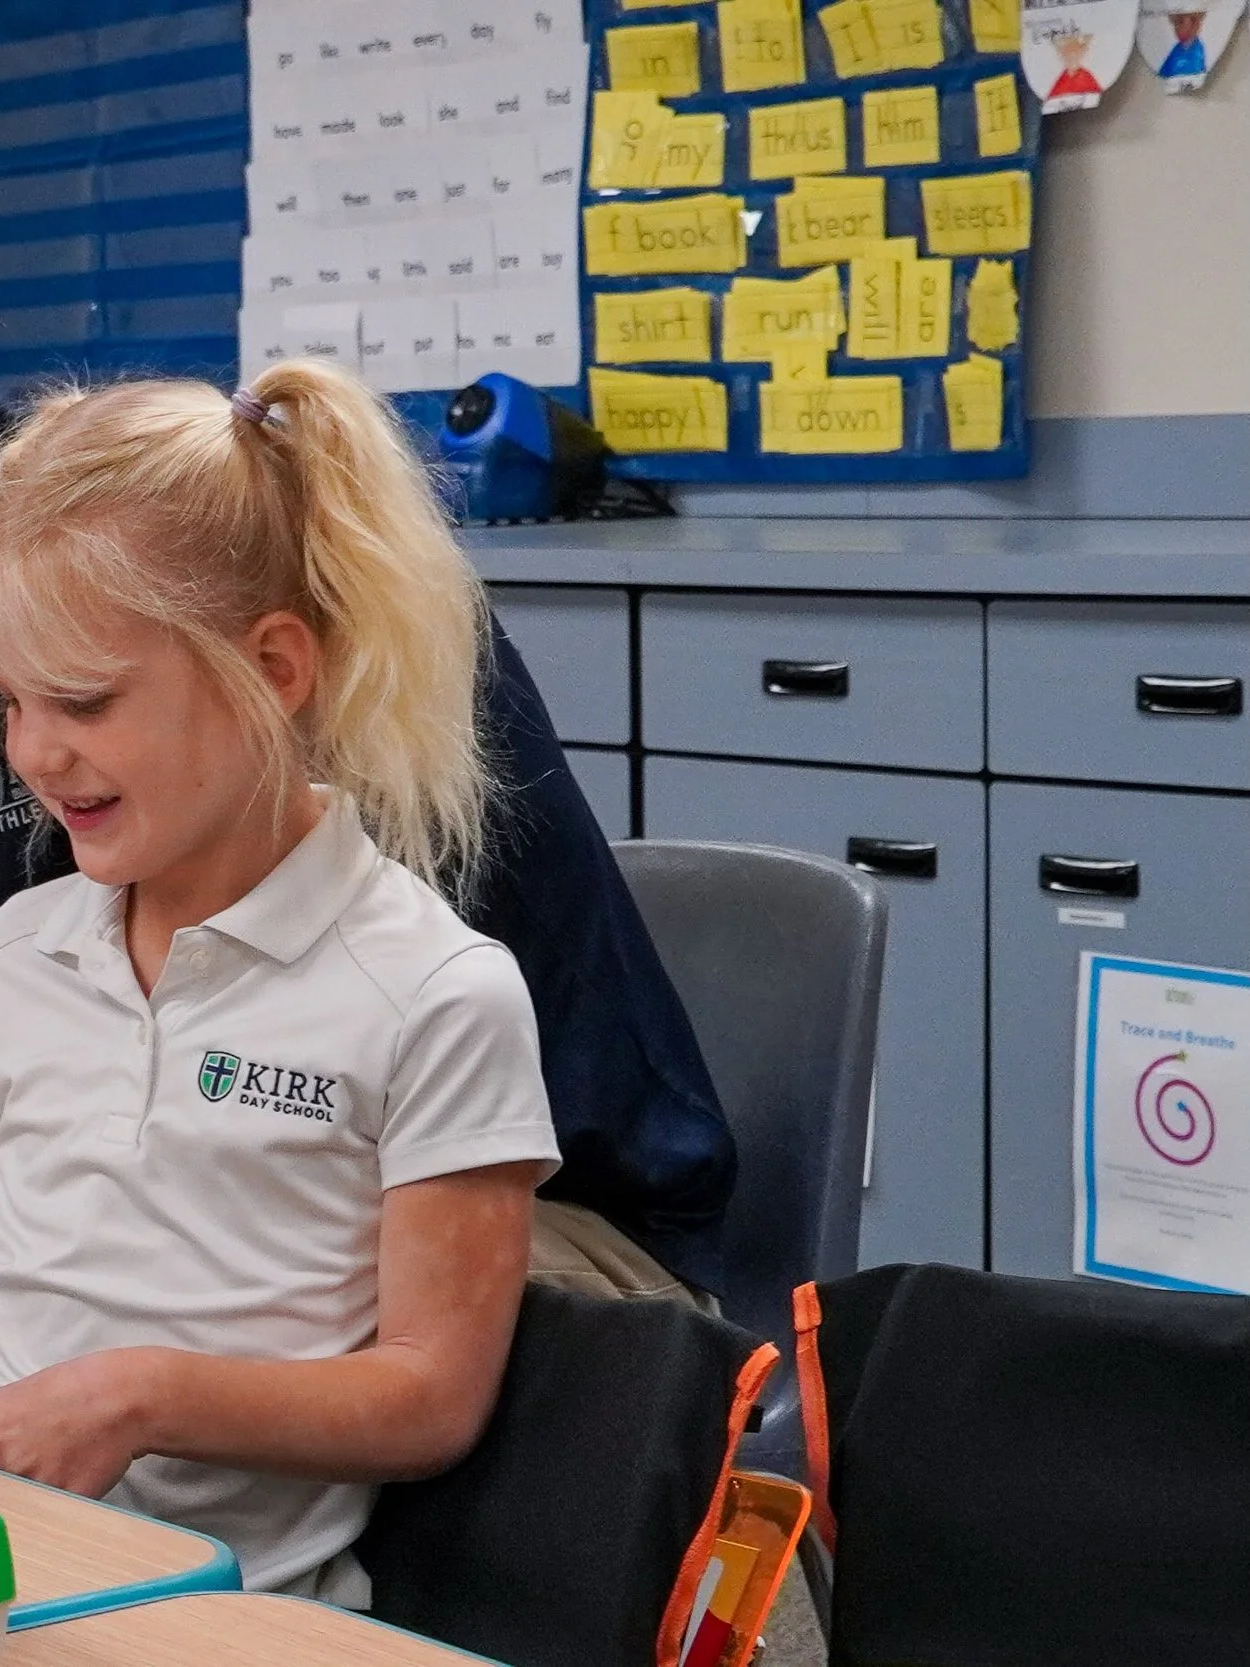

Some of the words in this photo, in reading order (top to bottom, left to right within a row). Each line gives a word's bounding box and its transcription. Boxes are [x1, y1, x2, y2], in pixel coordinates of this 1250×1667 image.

[666, 142, 713, 181] my
[633, 208, 717, 251] book
[759, 307, 815, 334] run
[604, 394, 690, 443] happy
[796, 392, 882, 433] down
[1120, 1020, 1154, 1040] Trace
[1157, 1028, 1183, 1042] and
[1185, 1031, 1237, 1050] Breathe
[241, 1061, 337, 1109] KIRK
[239, 1094, 271, 1110] DAY
[272, 1101, 334, 1123] SCHOOL
